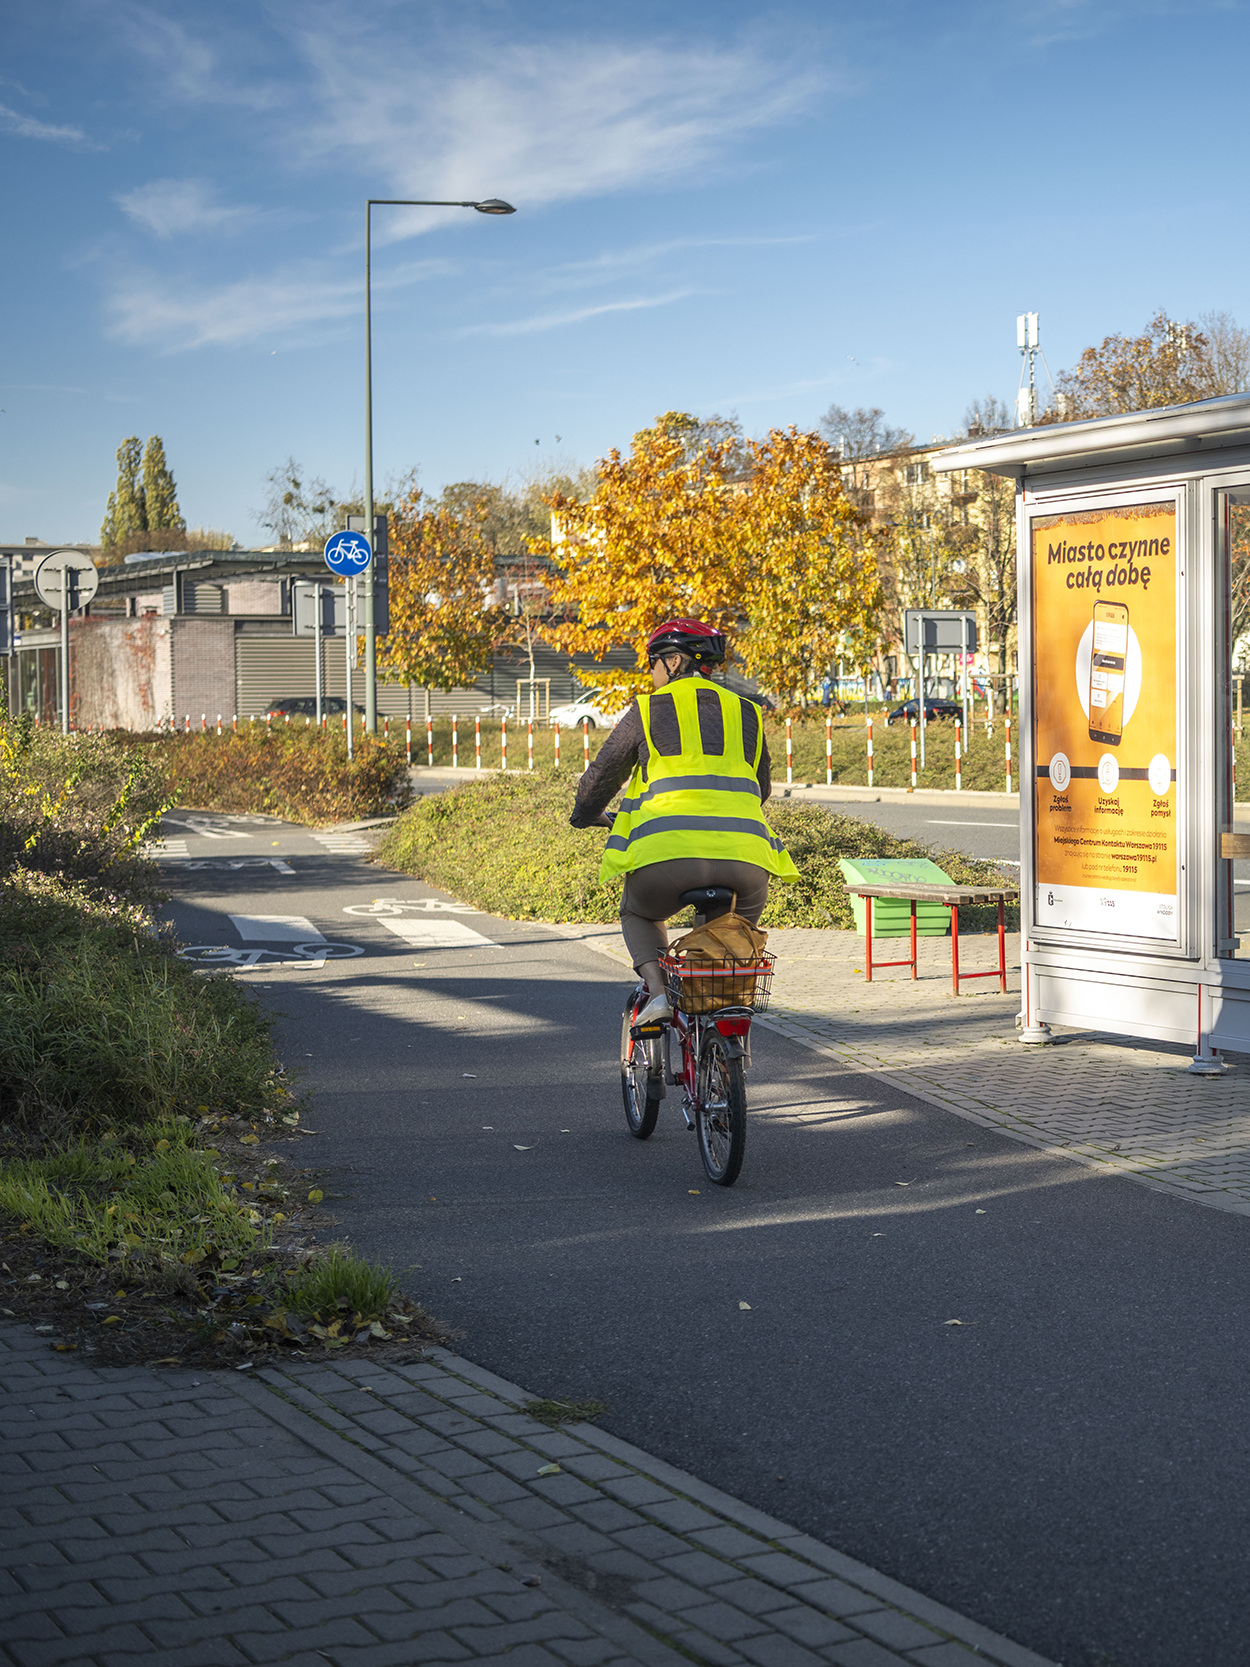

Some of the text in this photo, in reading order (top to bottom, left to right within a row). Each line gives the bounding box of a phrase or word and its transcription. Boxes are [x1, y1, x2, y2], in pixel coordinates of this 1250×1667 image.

[1047, 537, 1170, 565] Miasto czynne
[1066, 562, 1151, 593] całą dobę
[1097, 797, 1120, 807] Uzyskaj
[1049, 804, 1072, 813] problem
[1080, 838, 1102, 846] Centrum
[1101, 840, 1125, 848] Kontaktu
[1125, 841, 1153, 850] Warszawa
[1153, 842, 1168, 851] 19115
[1111, 853, 1158, 864] warszawa19115.pl
[1122, 865, 1138, 874] 19115
